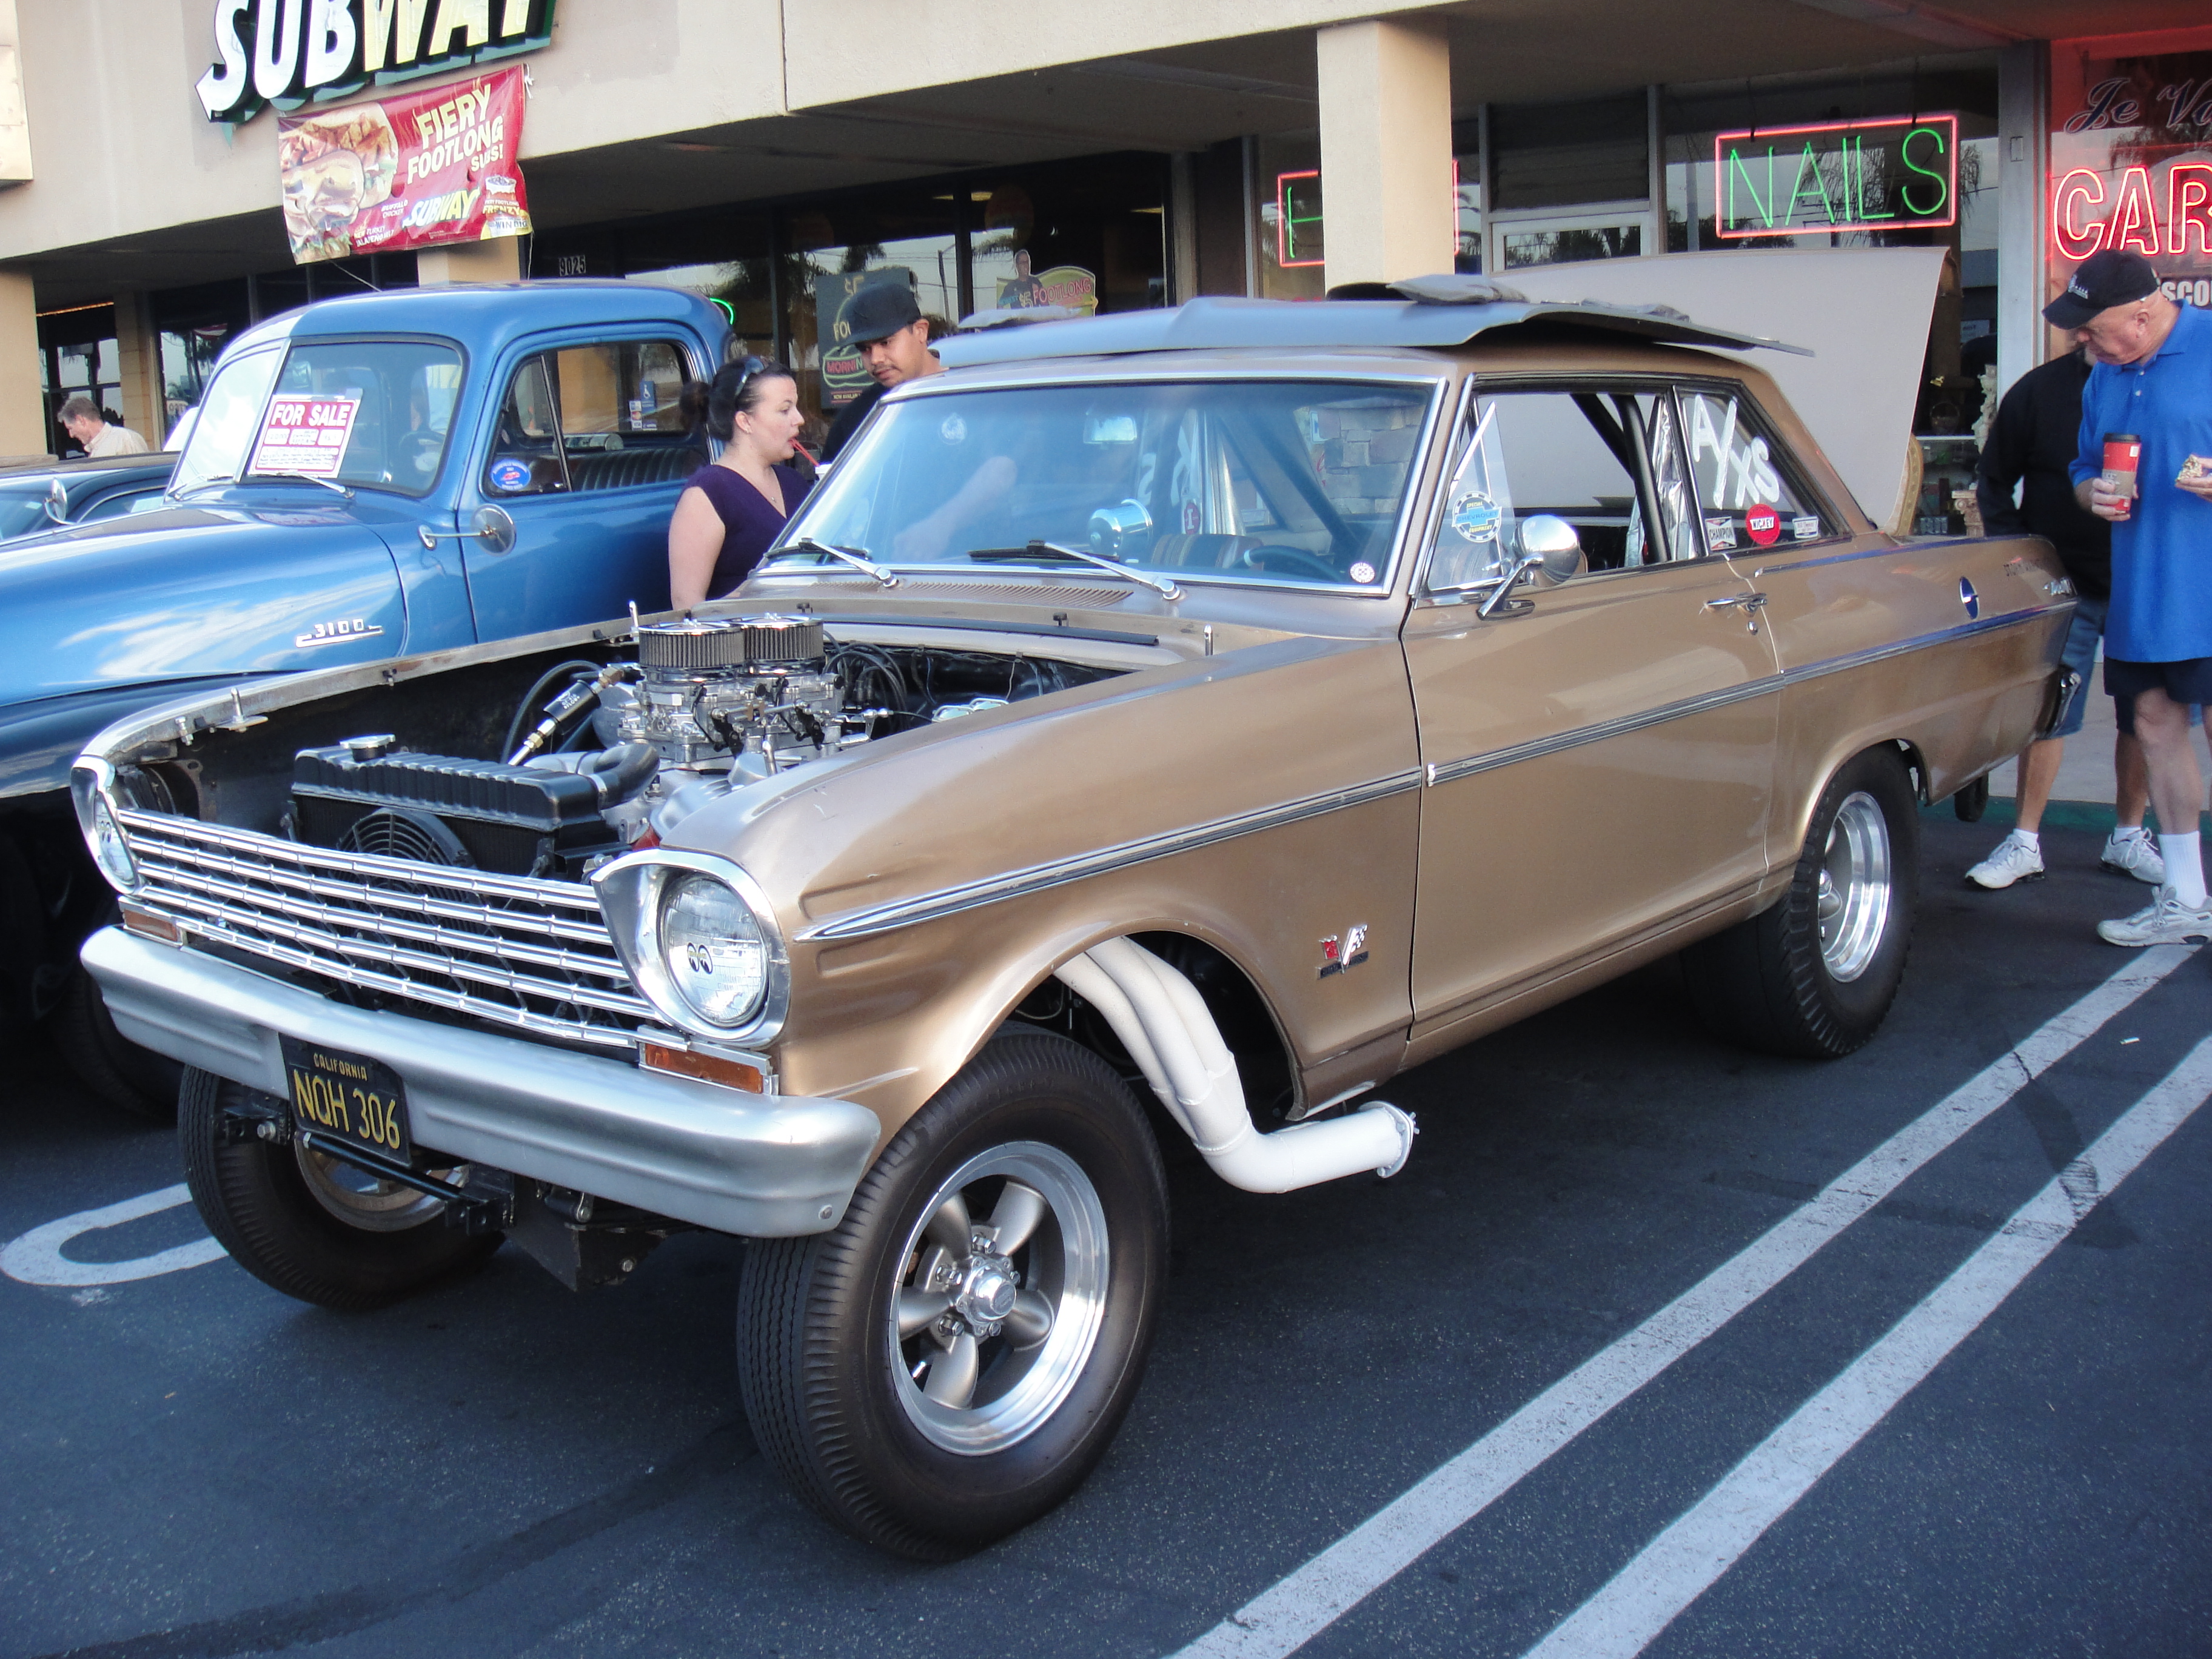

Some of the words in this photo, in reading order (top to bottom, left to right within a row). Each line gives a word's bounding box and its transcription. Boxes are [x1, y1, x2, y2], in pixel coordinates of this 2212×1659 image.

[417, 83, 491, 150] FIERY
[2063, 77, 2140, 134] Je
[407, 115, 504, 185] FOOTLONG
[471, 143, 504, 172] SUBS!
[1728, 127, 1947, 230] NAILS
[381, 199, 409, 212] BUFFALO
[402, 186, 481, 228] SUBWAY
[482, 205, 520, 215] FRENZY
[560, 255, 586, 276] 9025
[1033, 276, 1092, 305] FOOTLONG
[833, 321, 851, 342] FO
[270, 404, 306, 426] FOR
[308, 404, 352, 427] SALE
[1456, 511, 1498, 523] CHEVROLET
[1709, 527, 1733, 540] CHAMPION
[313, 618, 364, 638] 3100
[313, 1053, 368, 1082] CALIFORNIA
[353, 1088, 400, 1150] 306
